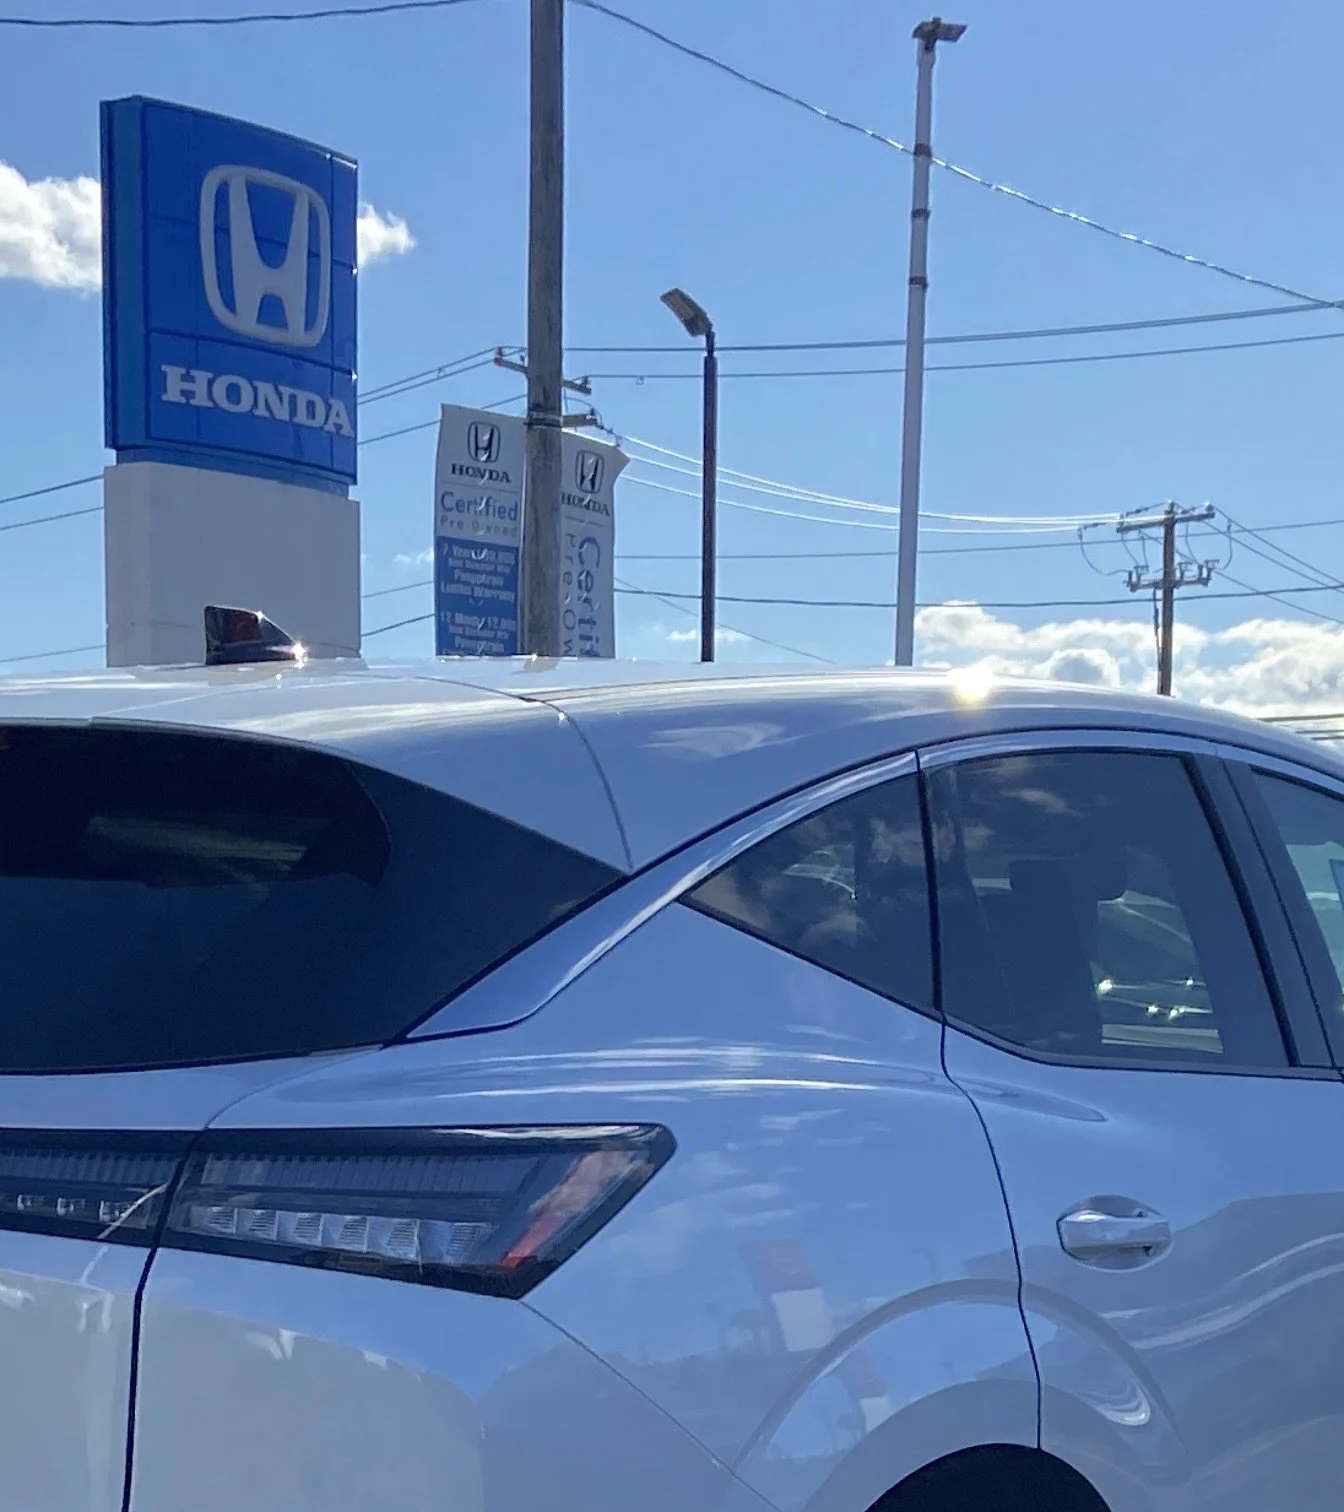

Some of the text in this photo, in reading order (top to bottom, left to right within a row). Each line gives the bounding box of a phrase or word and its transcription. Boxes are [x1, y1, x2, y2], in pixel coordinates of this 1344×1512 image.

[161, 365, 354, 437] HONDA
[451, 463, 512, 483] HONDA
[440, 490, 518, 521] Certified
[561, 493, 611, 517] HONDA
